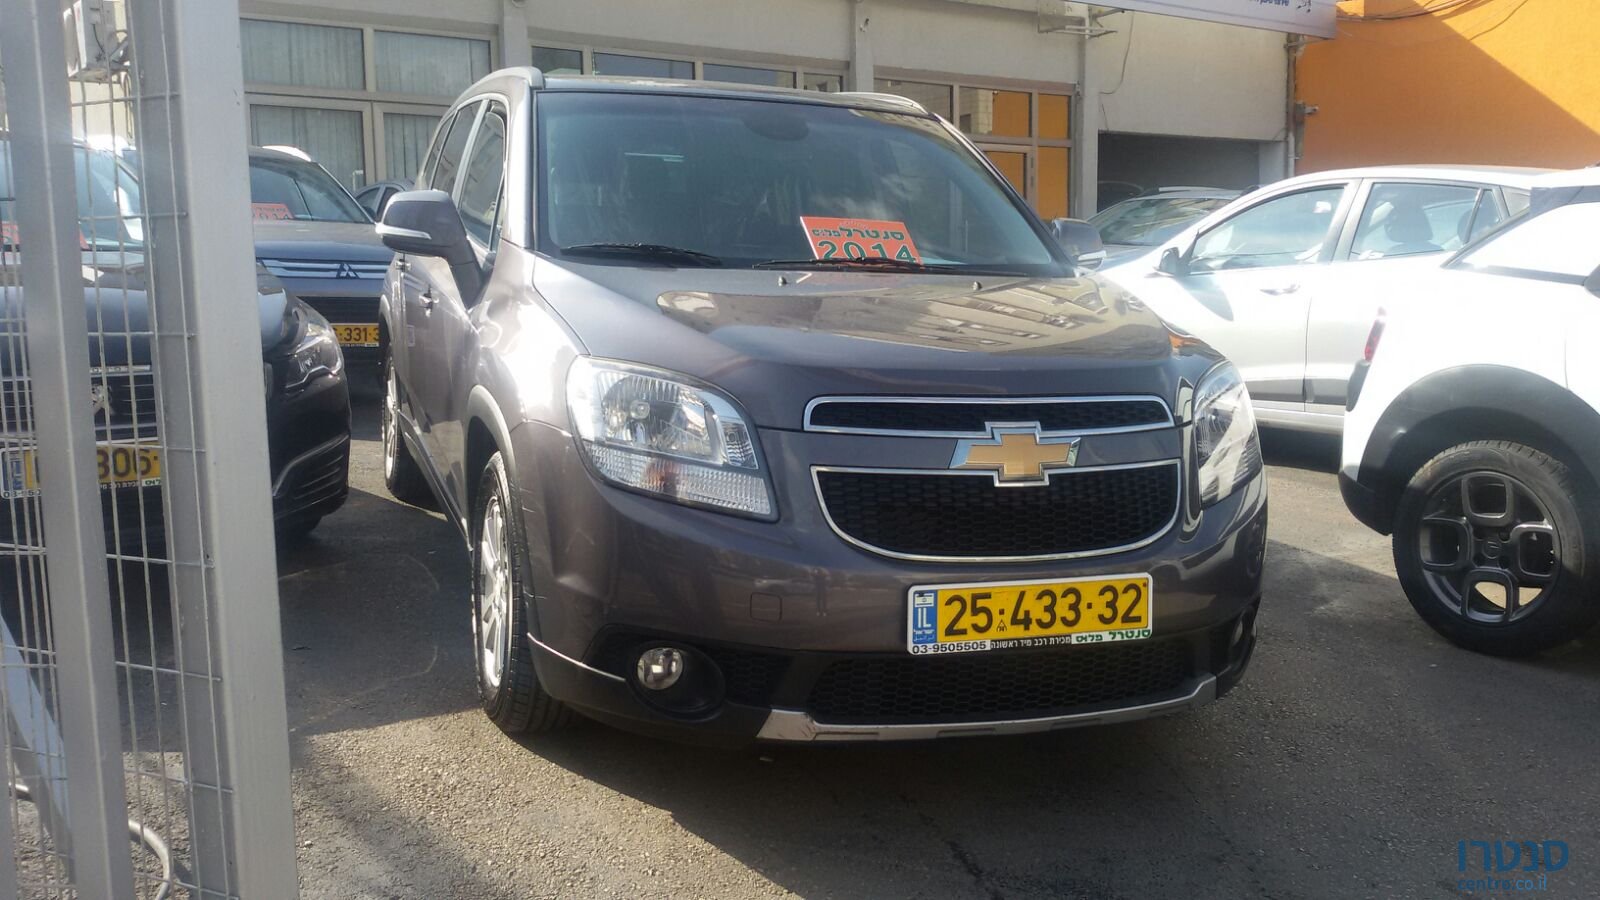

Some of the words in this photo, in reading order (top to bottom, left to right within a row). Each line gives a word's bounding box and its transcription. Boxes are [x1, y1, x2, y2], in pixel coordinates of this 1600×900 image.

[839, 226, 905, 241] סנטרל
[818, 240, 917, 262] 2014
[918, 607, 932, 628] IL
[1076, 634, 1103, 643] פלוס
[1109, 629, 1151, 640] סנטרל
[912, 640, 987, 655] 03-9505505
